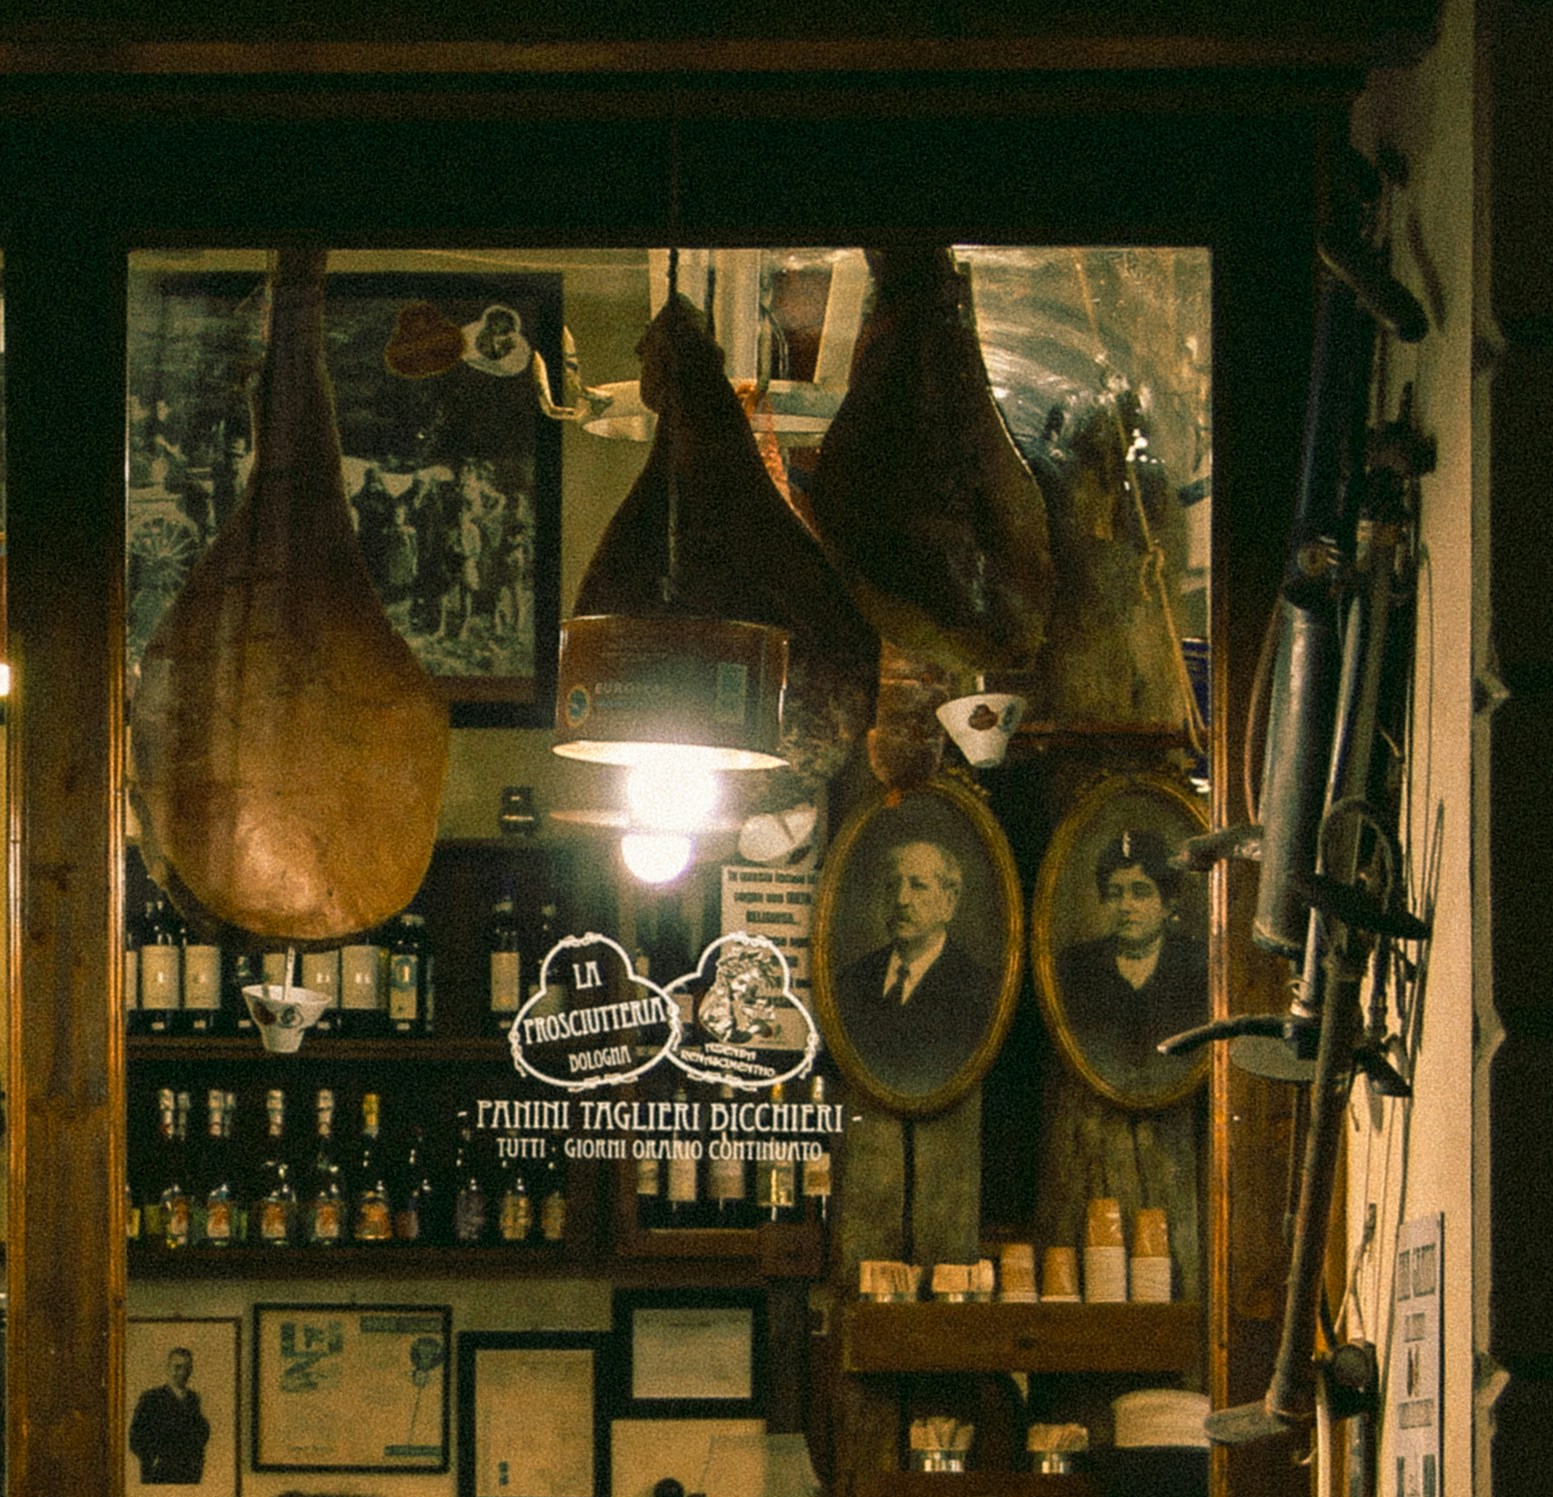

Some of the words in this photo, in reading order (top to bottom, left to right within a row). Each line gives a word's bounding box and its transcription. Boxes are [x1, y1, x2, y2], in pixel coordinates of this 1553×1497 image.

[573, 962, 601, 989] LA
[523, 997, 666, 1044] PROSCIUTTERIA
[568, 1045, 632, 1073] BOLOGNA
[477, 1101, 570, 1130] PANINI
[580, 1102, 700, 1131] TAGLIERI
[710, 1102, 843, 1132] BICCHIERI
[498, 1139, 545, 1158] TUTTI
[564, 1139, 626, 1159] GIORNI
[632, 1140, 703, 1160] ORARIO
[709, 1140, 822, 1160] CONTINUATO
